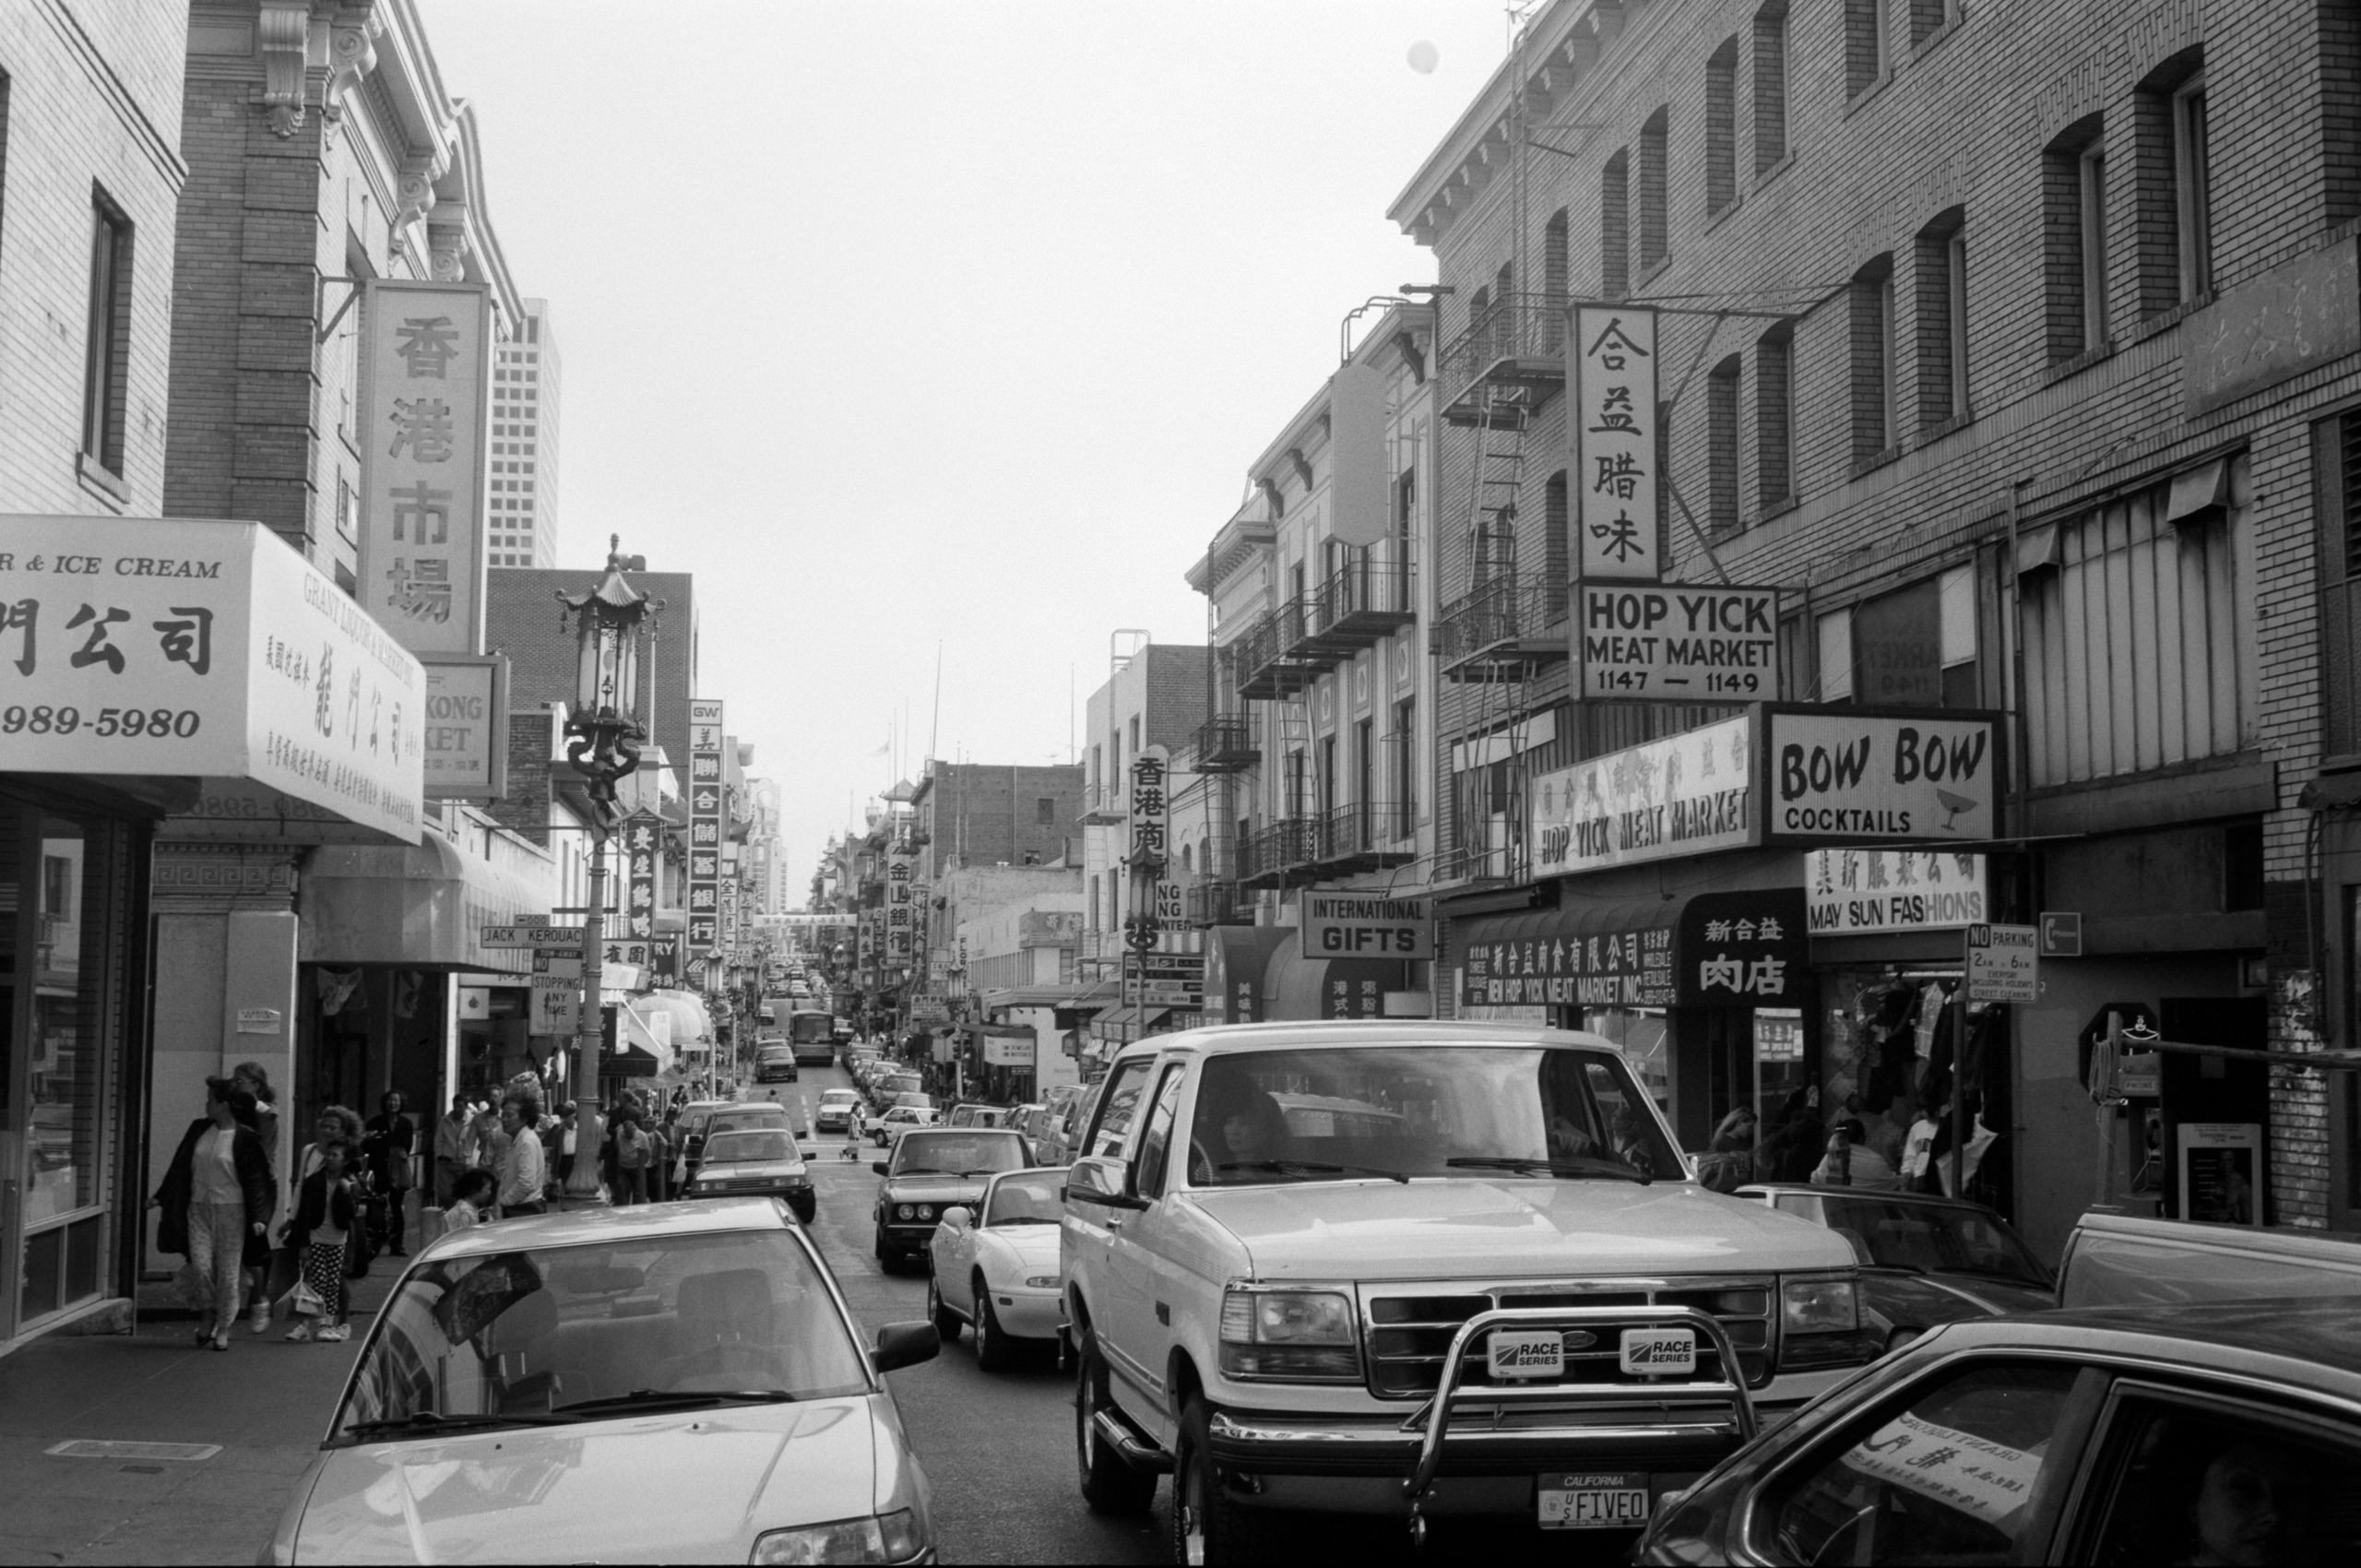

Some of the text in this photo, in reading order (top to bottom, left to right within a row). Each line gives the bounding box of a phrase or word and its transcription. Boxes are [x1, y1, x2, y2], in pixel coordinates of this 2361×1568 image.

[386, 316, 459, 624] 香港市場
[26, 554, 44, 572] &
[53, 555, 102, 575] ICE
[114, 557, 221, 578] CREAM
[305, 572, 340, 624] GRANT
[1589, 593, 1773, 634] HOP YICK
[1585, 636, 1774, 667] MEAT MARKET
[1598, 671, 1649, 690] 1147
[1705, 673, 1759, 693] 1149
[3, 706, 200, 738] 989-5980
[1780, 735, 1870, 802] BOW
[1893, 727, 1987, 785] BOW
[1541, 787, 1749, 865] HOP YICK MEAT MARKET
[1786, 807, 1911, 833] COCKTAILS
[1313, 898, 1424, 920] INTERNATIONAL
[1810, 891, 1982, 930] MAY SUN FASHIONS
[484, 929, 581, 942] JACK KEROUAC
[1323, 927, 1416, 952] GIFTS
[1705, 917, 1783, 943] 新合益
[1970, 926, 2034, 948] NO PARKING
[534, 958, 548, 970] NO
[1700, 953, 1787, 995] 肉店
[534, 977, 579, 990] STOPPING
[1505, 979, 1523, 1003] HOP
[1525, 979, 1545, 1003] YICK
[1547, 978, 1574, 1003] MEAT
[1578, 976, 1620, 1004] MARKET
[1623, 975, 1644, 1004] INC.
[1973, 988, 1997, 997] STREET
[545, 992, 567, 1002] ANY
[1520, 1343, 1560, 1355] RACE
[1652, 1353, 1691, 1363] SERIES
[1653, 1341, 1691, 1353] RACE
[1519, 1356, 1559, 1366] SERIES
[1564, 1476, 1624, 1486] CALIFORNIA
